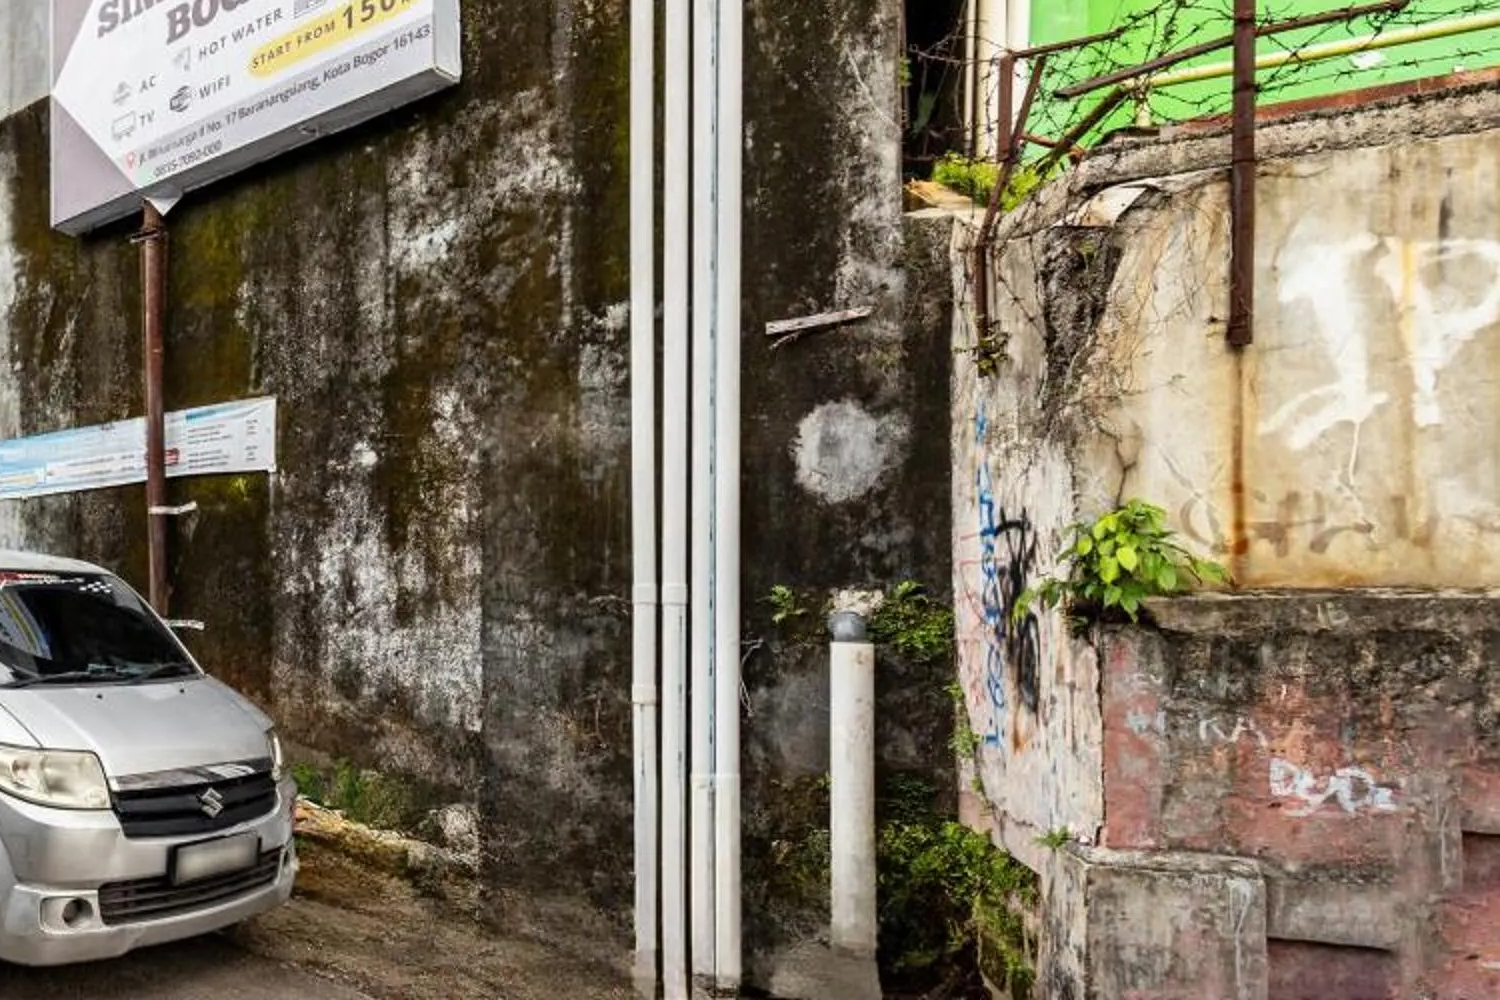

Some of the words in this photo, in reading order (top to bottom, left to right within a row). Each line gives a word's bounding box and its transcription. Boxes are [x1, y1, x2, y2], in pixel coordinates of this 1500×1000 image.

[199, 35, 226, 61] HOT
[232, 8, 283, 42] WATER
[252, 40, 292, 69] START
[297, 20, 335, 48] FROM
[140, 75, 156, 93] AC
[199, 75, 230, 99] WIFI
[225, 111, 237, 125] 17
[323, 61, 351, 83] Kota
[353, 44, 389, 69] Bogor
[140, 111, 155, 127] TV
